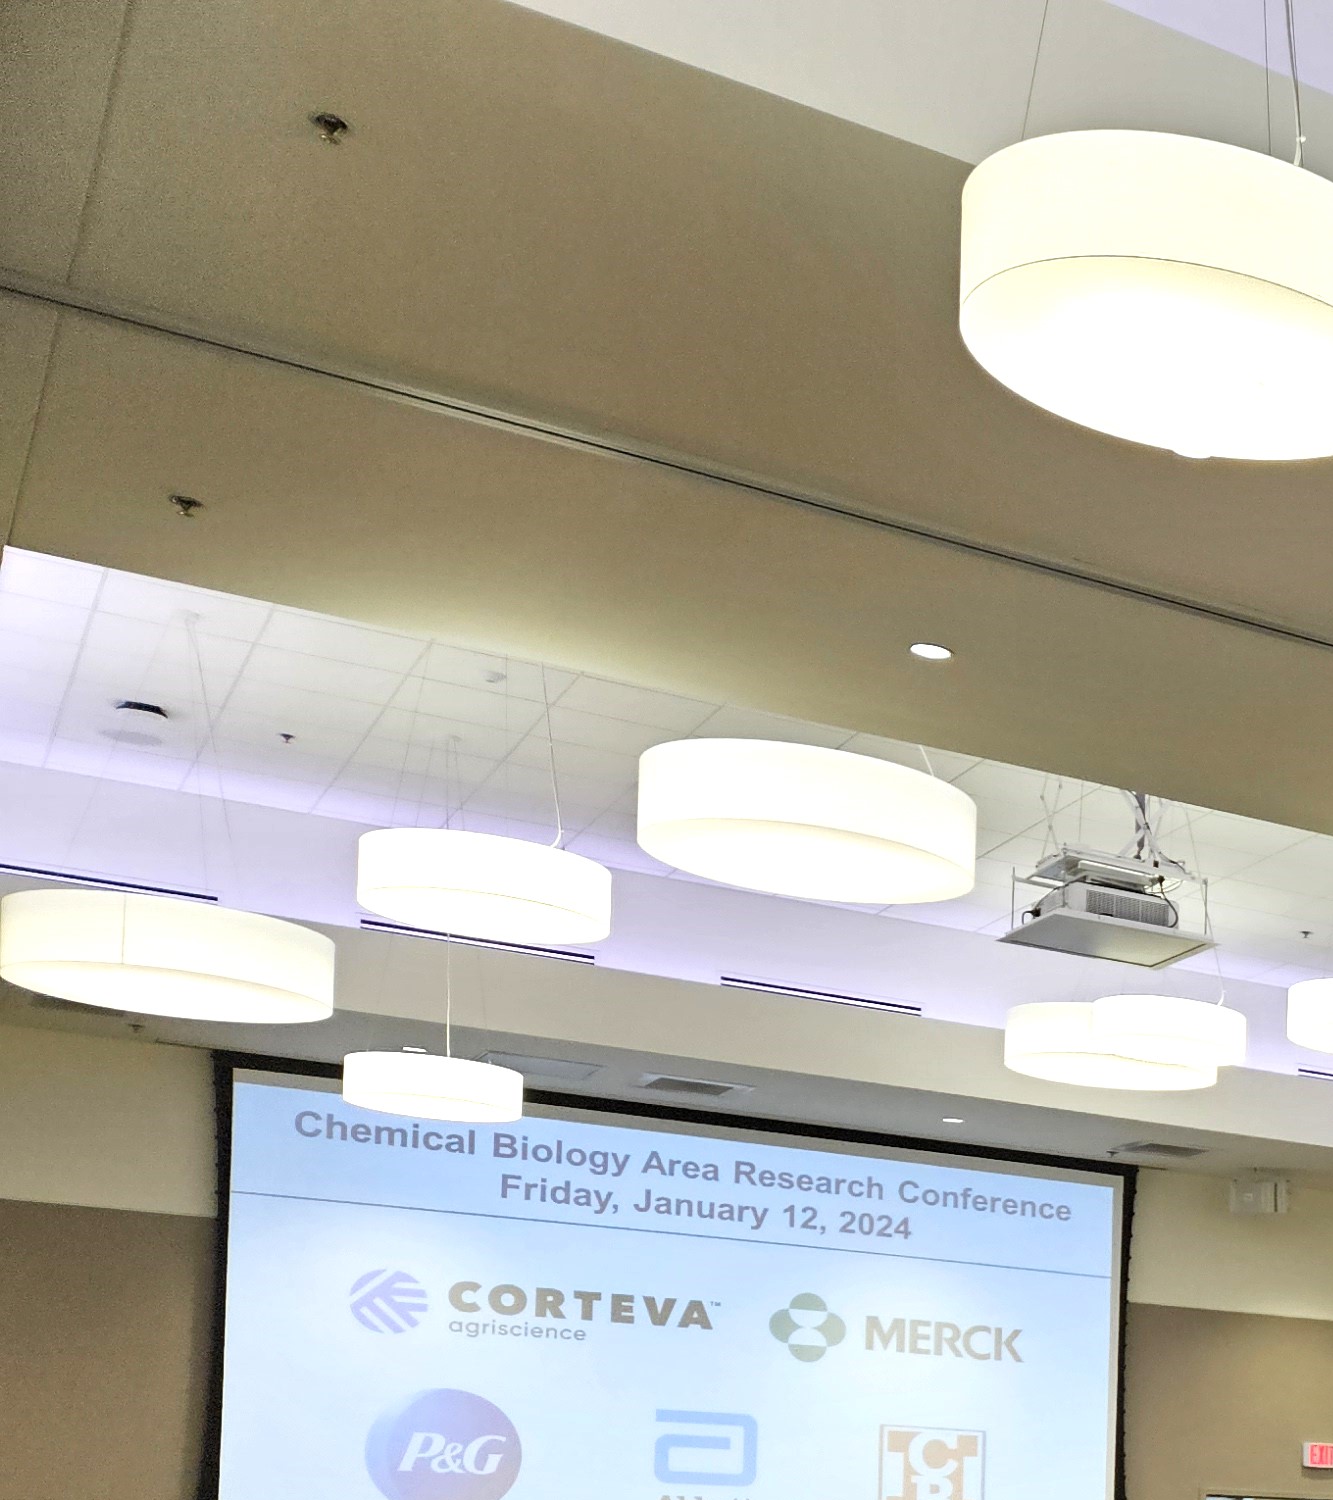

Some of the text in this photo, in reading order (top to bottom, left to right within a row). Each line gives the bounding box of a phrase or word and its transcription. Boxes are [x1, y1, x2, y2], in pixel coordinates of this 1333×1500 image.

[295, 1110, 1072, 1221] Chemical Biology Area Research Conference
[501, 1174, 912, 1240] Friday, January 12, 2024
[448, 1281, 713, 1330] CORTEVA
[448, 1319, 587, 1341] agriscience
[865, 1315, 1024, 1363] MERCK
[397, 1431, 507, 1475] P&G
